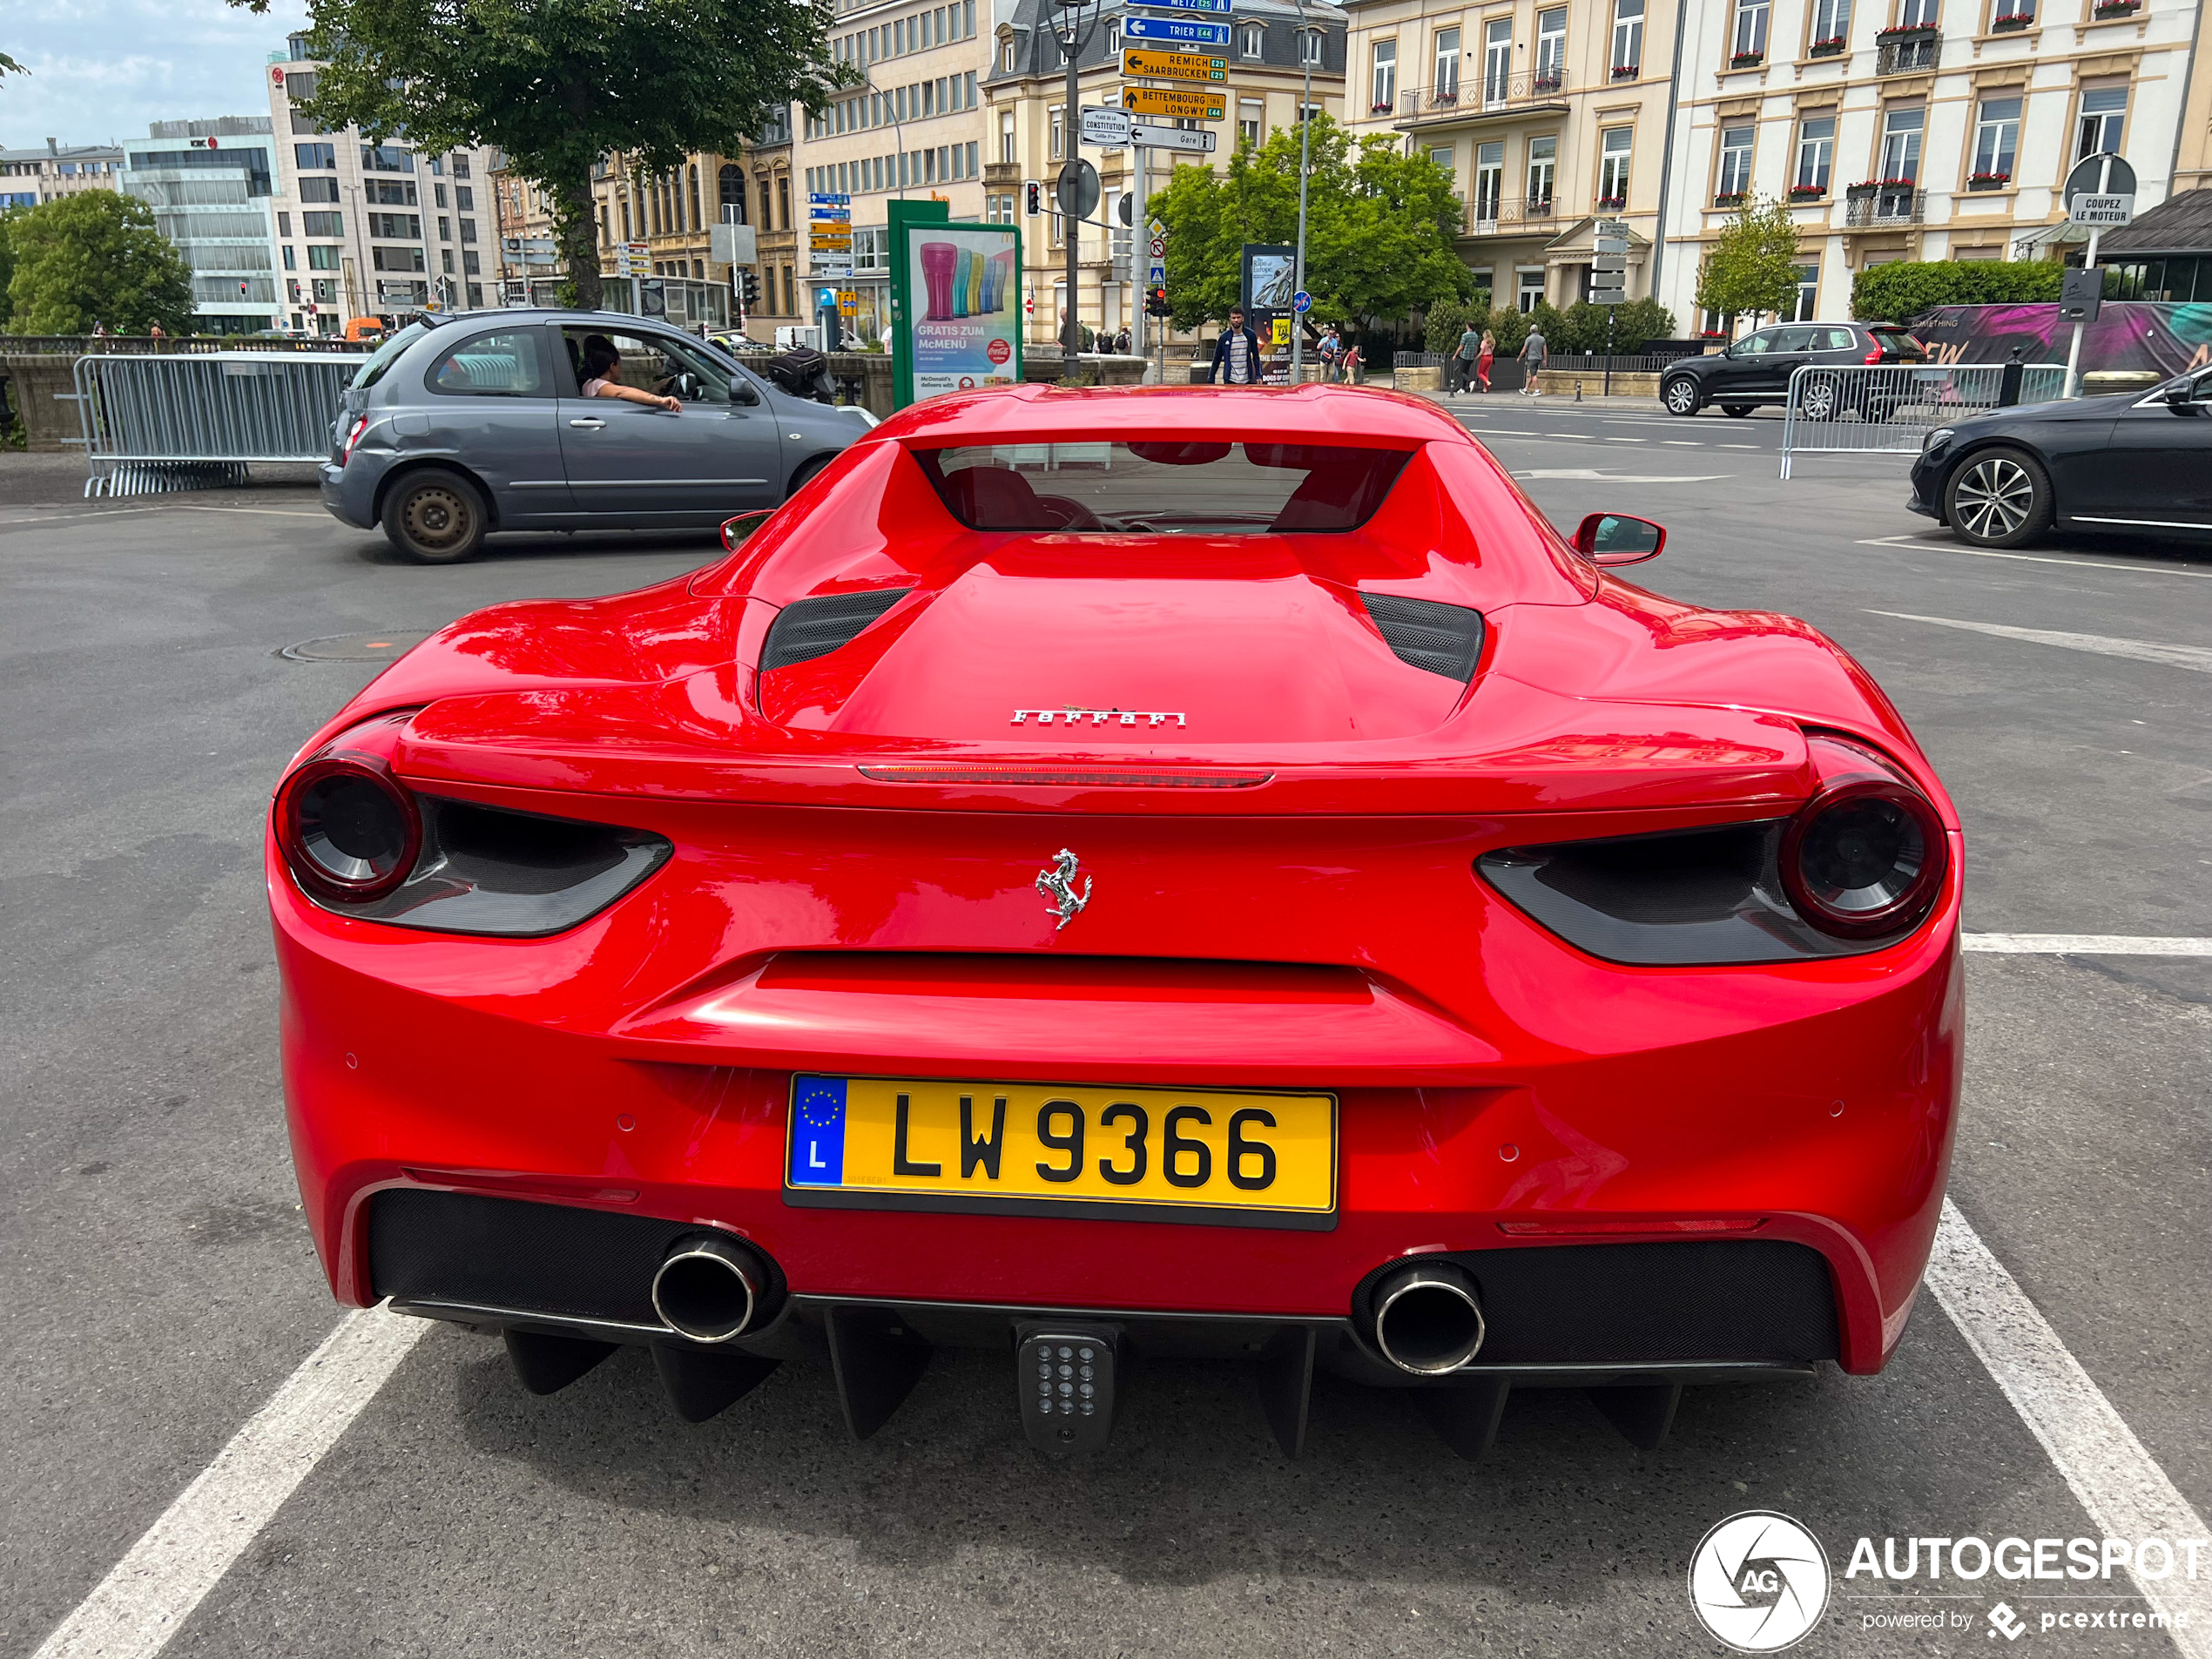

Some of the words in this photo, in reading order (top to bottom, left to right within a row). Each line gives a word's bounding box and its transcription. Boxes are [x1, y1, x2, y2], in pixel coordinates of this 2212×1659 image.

[1170, 25, 1194, 37] TRIER
[1198, 28, 1211, 37] E44
[1170, 55, 1208, 68] REMICH
[1211, 59, 1224, 68] E29
[1143, 64, 1208, 78] SAARBRUCKEN
[1143, 91, 1205, 105] BETTEMBOURG
[1165, 104, 1205, 116] LONGWY
[1086, 120, 1125, 132] CONSTITUTION
[1180, 135, 1197, 145] Gare
[2086, 199, 2121, 209] COUPEZ
[2075, 211, 2087, 220] LE
[2089, 211, 2127, 221] MOTEUR
[1911, 319, 1959, 328] SOMETHING
[918, 325, 958, 336] GRATIS
[960, 326, 985, 336] ZUM
[918, 336, 968, 349] McMENÜ
[1010, 709, 1186, 726] Ferrari
[894, 1091, 1008, 1180] LW
[1035, 1099, 1278, 1190] 9366
[809, 1140, 826, 1168] L
